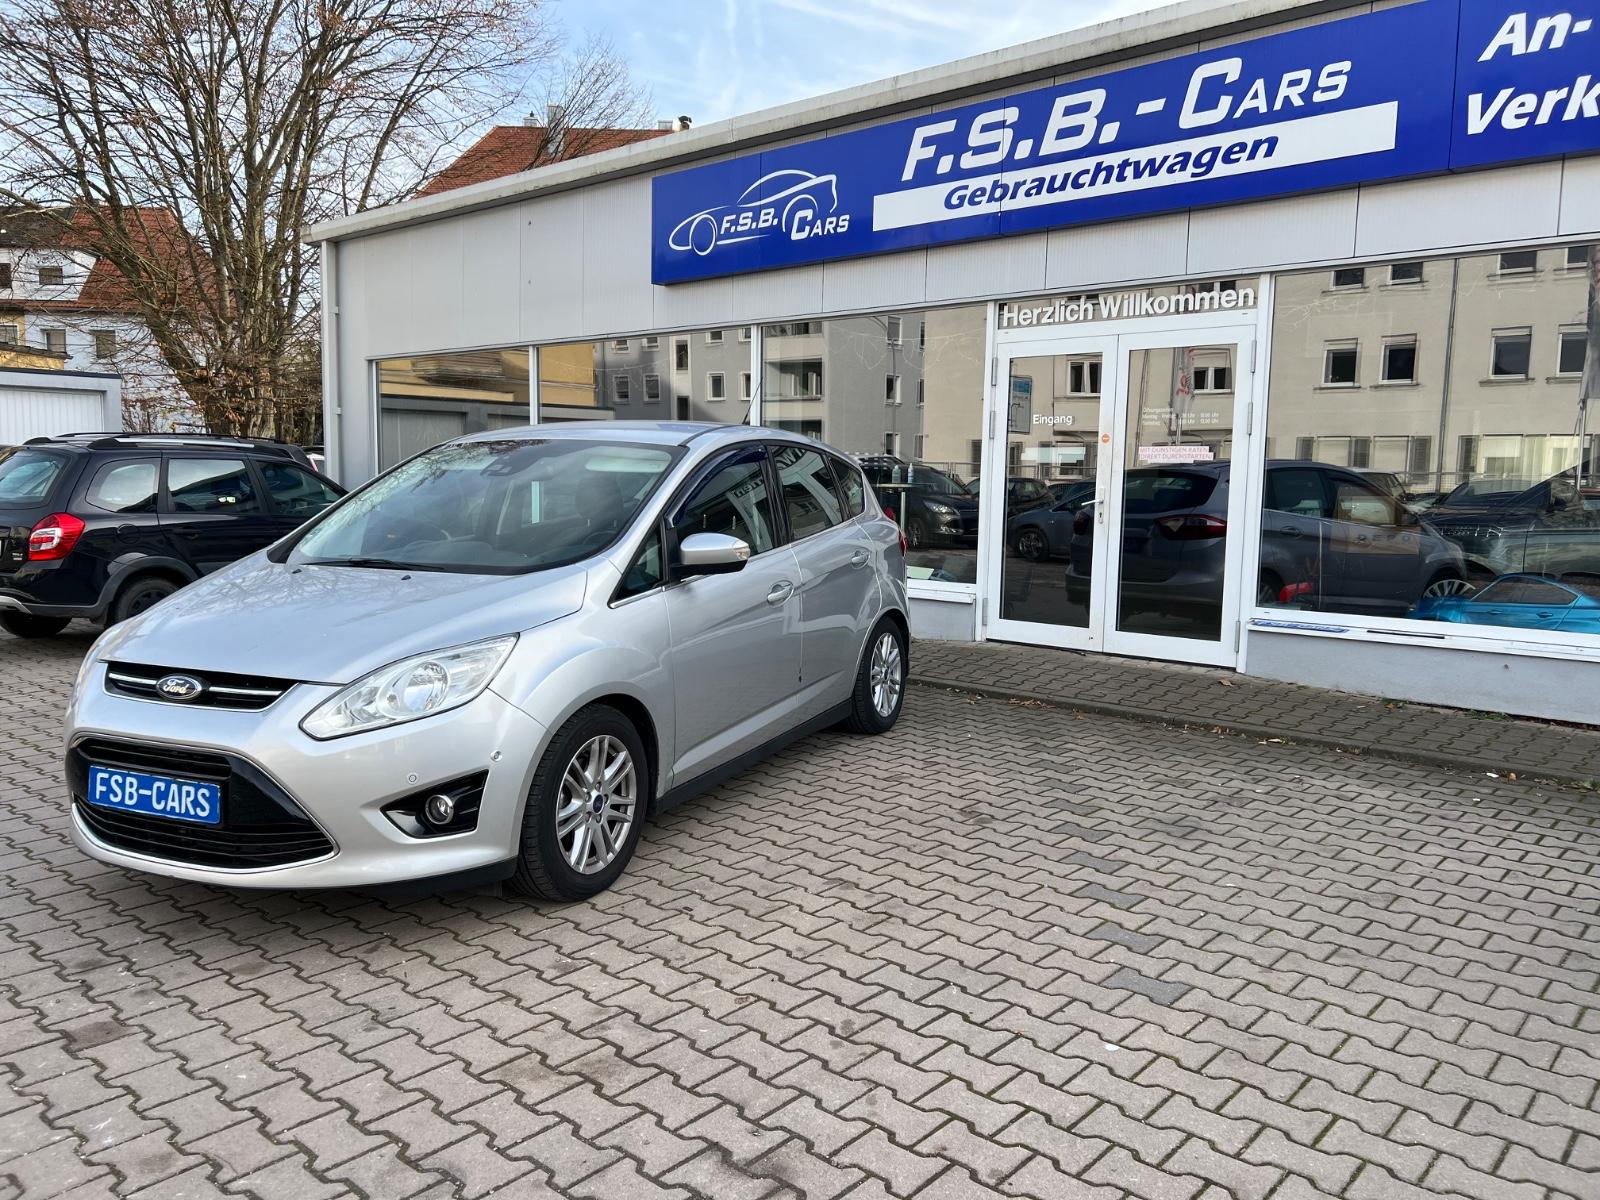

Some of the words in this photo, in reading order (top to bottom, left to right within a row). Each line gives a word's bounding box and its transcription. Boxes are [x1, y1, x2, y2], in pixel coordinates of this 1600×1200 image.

[1477, 12, 1592, 63] An-
[1467, 74, 1600, 136] Verk
[944, 134, 1279, 210] Gebrauchtwagen
[720, 207, 778, 235] F.S.B.
[1001, 299, 1093, 327] Herzlich
[1099, 287, 1255, 319] Willkommen
[1032, 414, 1073, 425] Eingang
[162, 678, 190, 695] Ford
[95, 772, 211, 818] FSB-CARS
